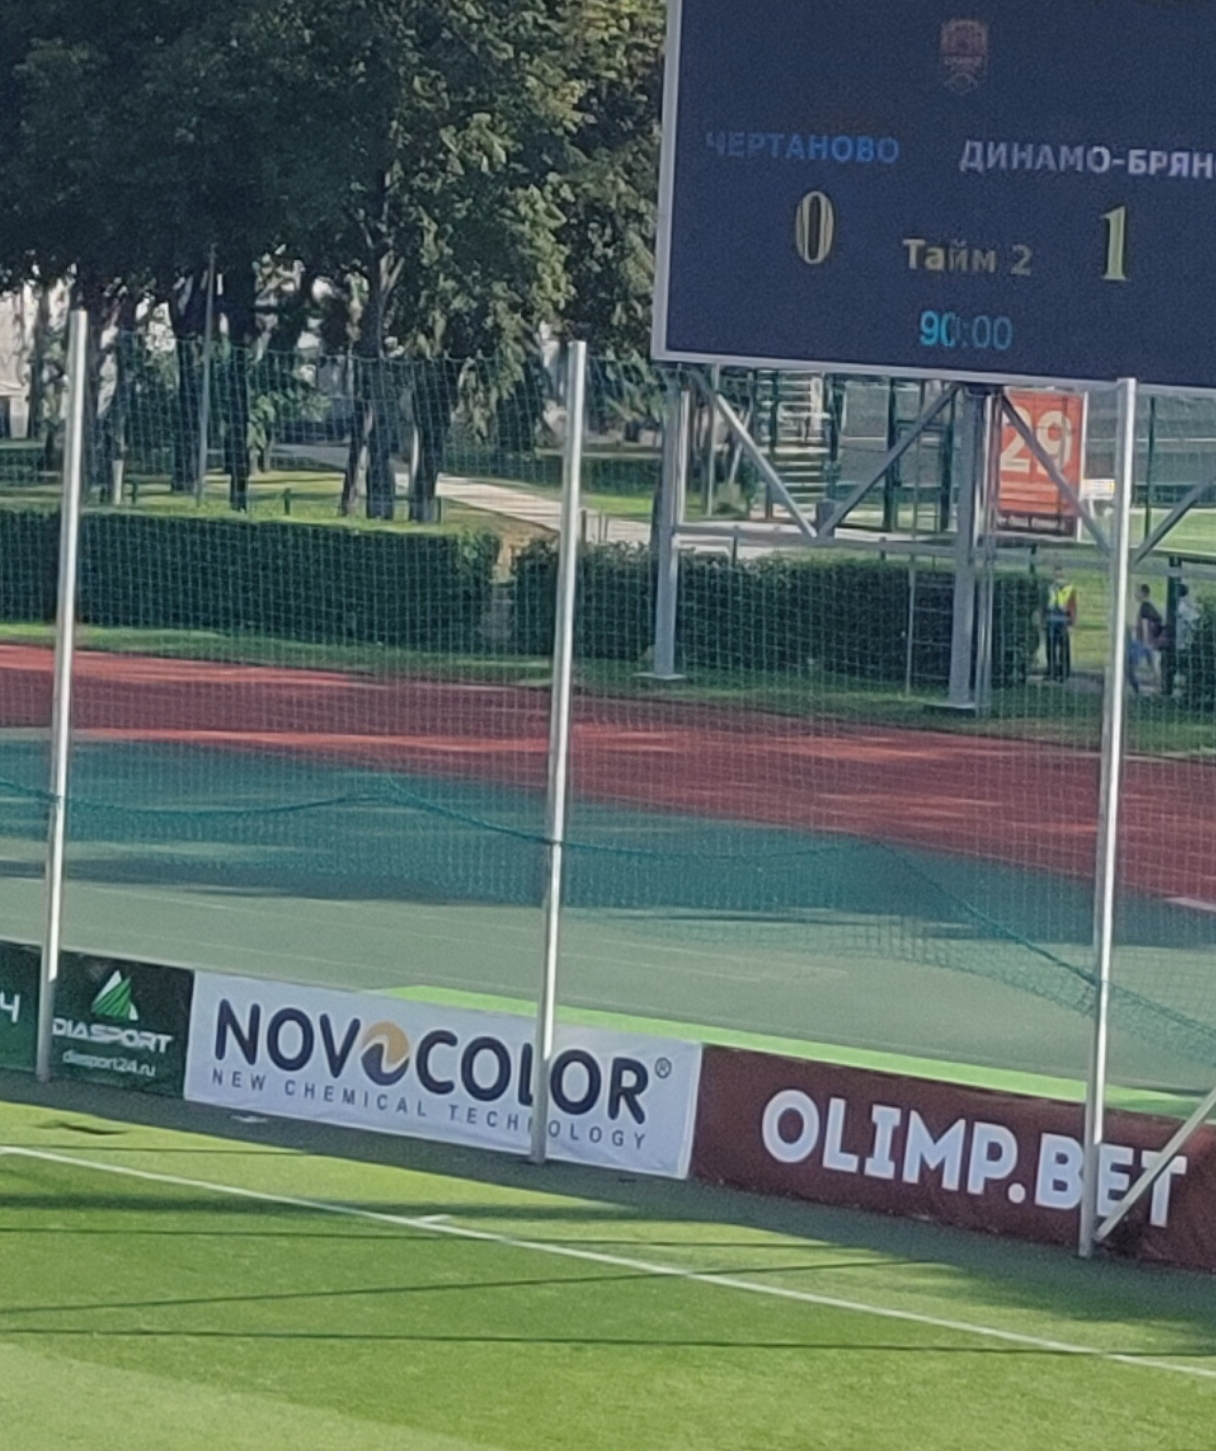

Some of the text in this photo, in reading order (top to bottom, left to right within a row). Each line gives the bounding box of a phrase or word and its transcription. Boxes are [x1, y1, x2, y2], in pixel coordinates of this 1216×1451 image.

[706, 131, 900, 164] ЧЕРТАНОВО
[796, 191, 834, 264] 0
[1100, 204, 1129, 281] 1
[902, 238, 1033, 276] Тайм 2
[920, 310, 1012, 350] 90:00
[52, 1017, 174, 1053] DIASPORT
[62, 1049, 156, 1077] diasport24.ru
[212, 1068, 646, 1150] NEW CHEMICAL TECHOLOGY
[761, 1089, 1188, 1228] OLIMP.BET
